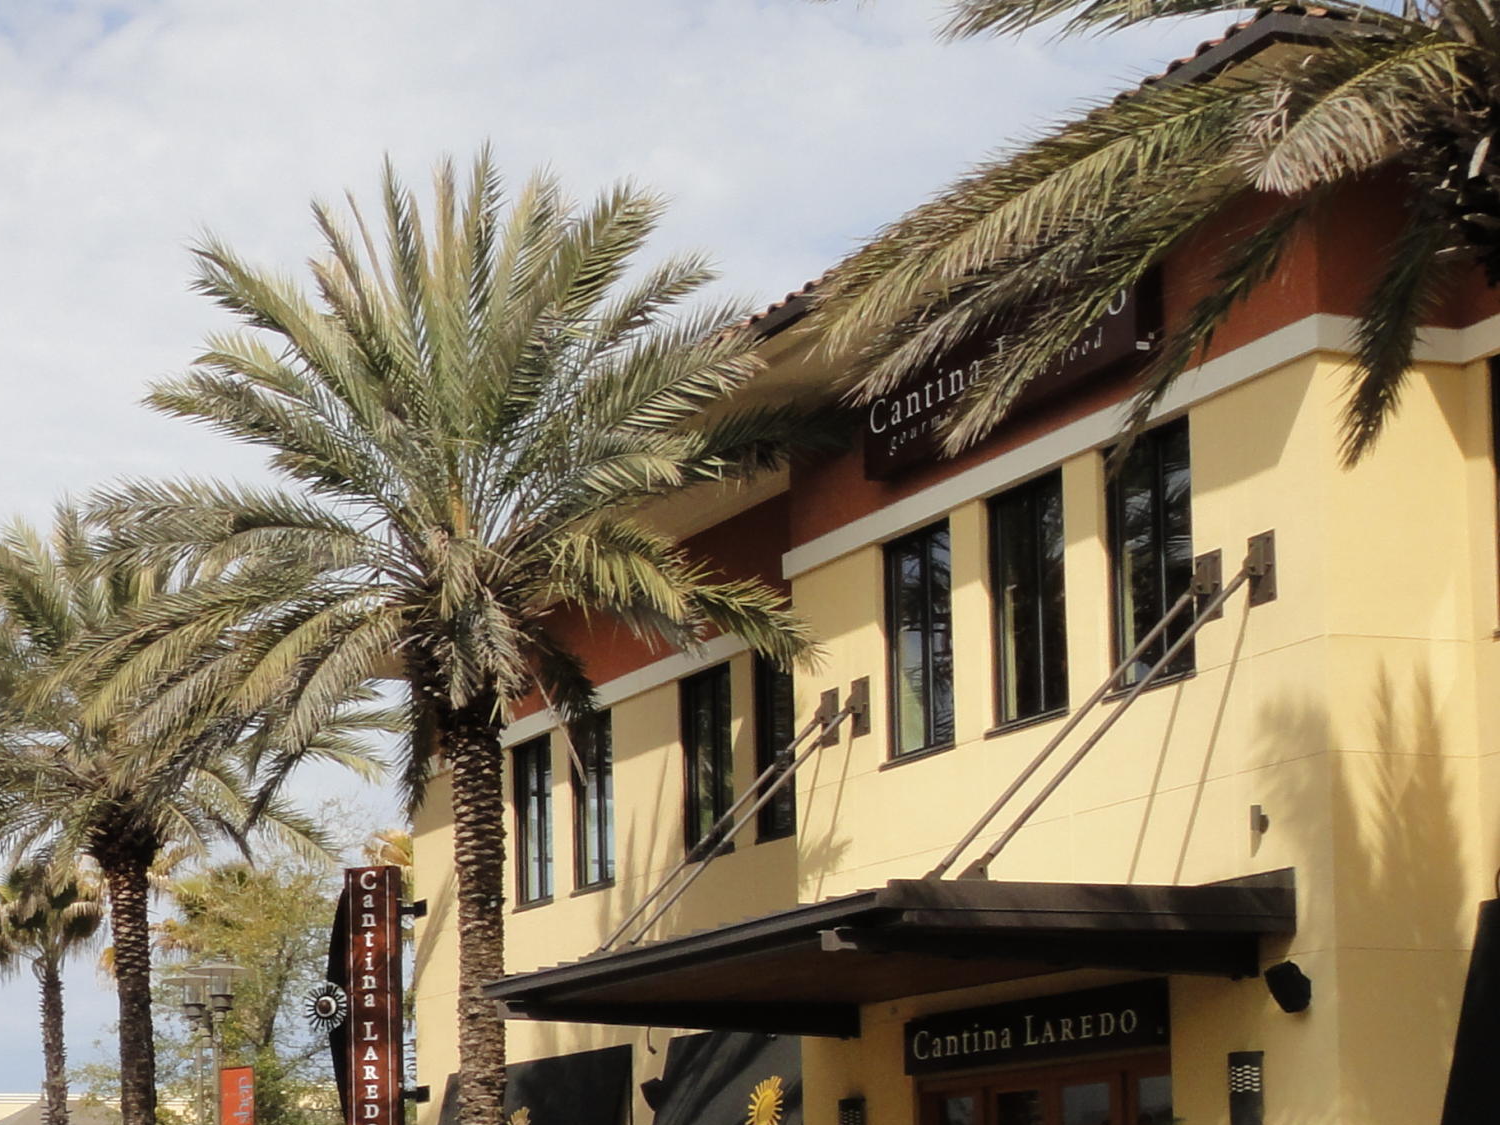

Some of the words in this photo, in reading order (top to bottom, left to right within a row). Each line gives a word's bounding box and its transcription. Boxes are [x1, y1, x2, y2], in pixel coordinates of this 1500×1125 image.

[870, 357, 982, 434] Cantina
[359, 870, 377, 1008] Cantina
[913, 1023, 1012, 1060] Cantina
[1023, 1008, 1139, 1047] LAREDO
